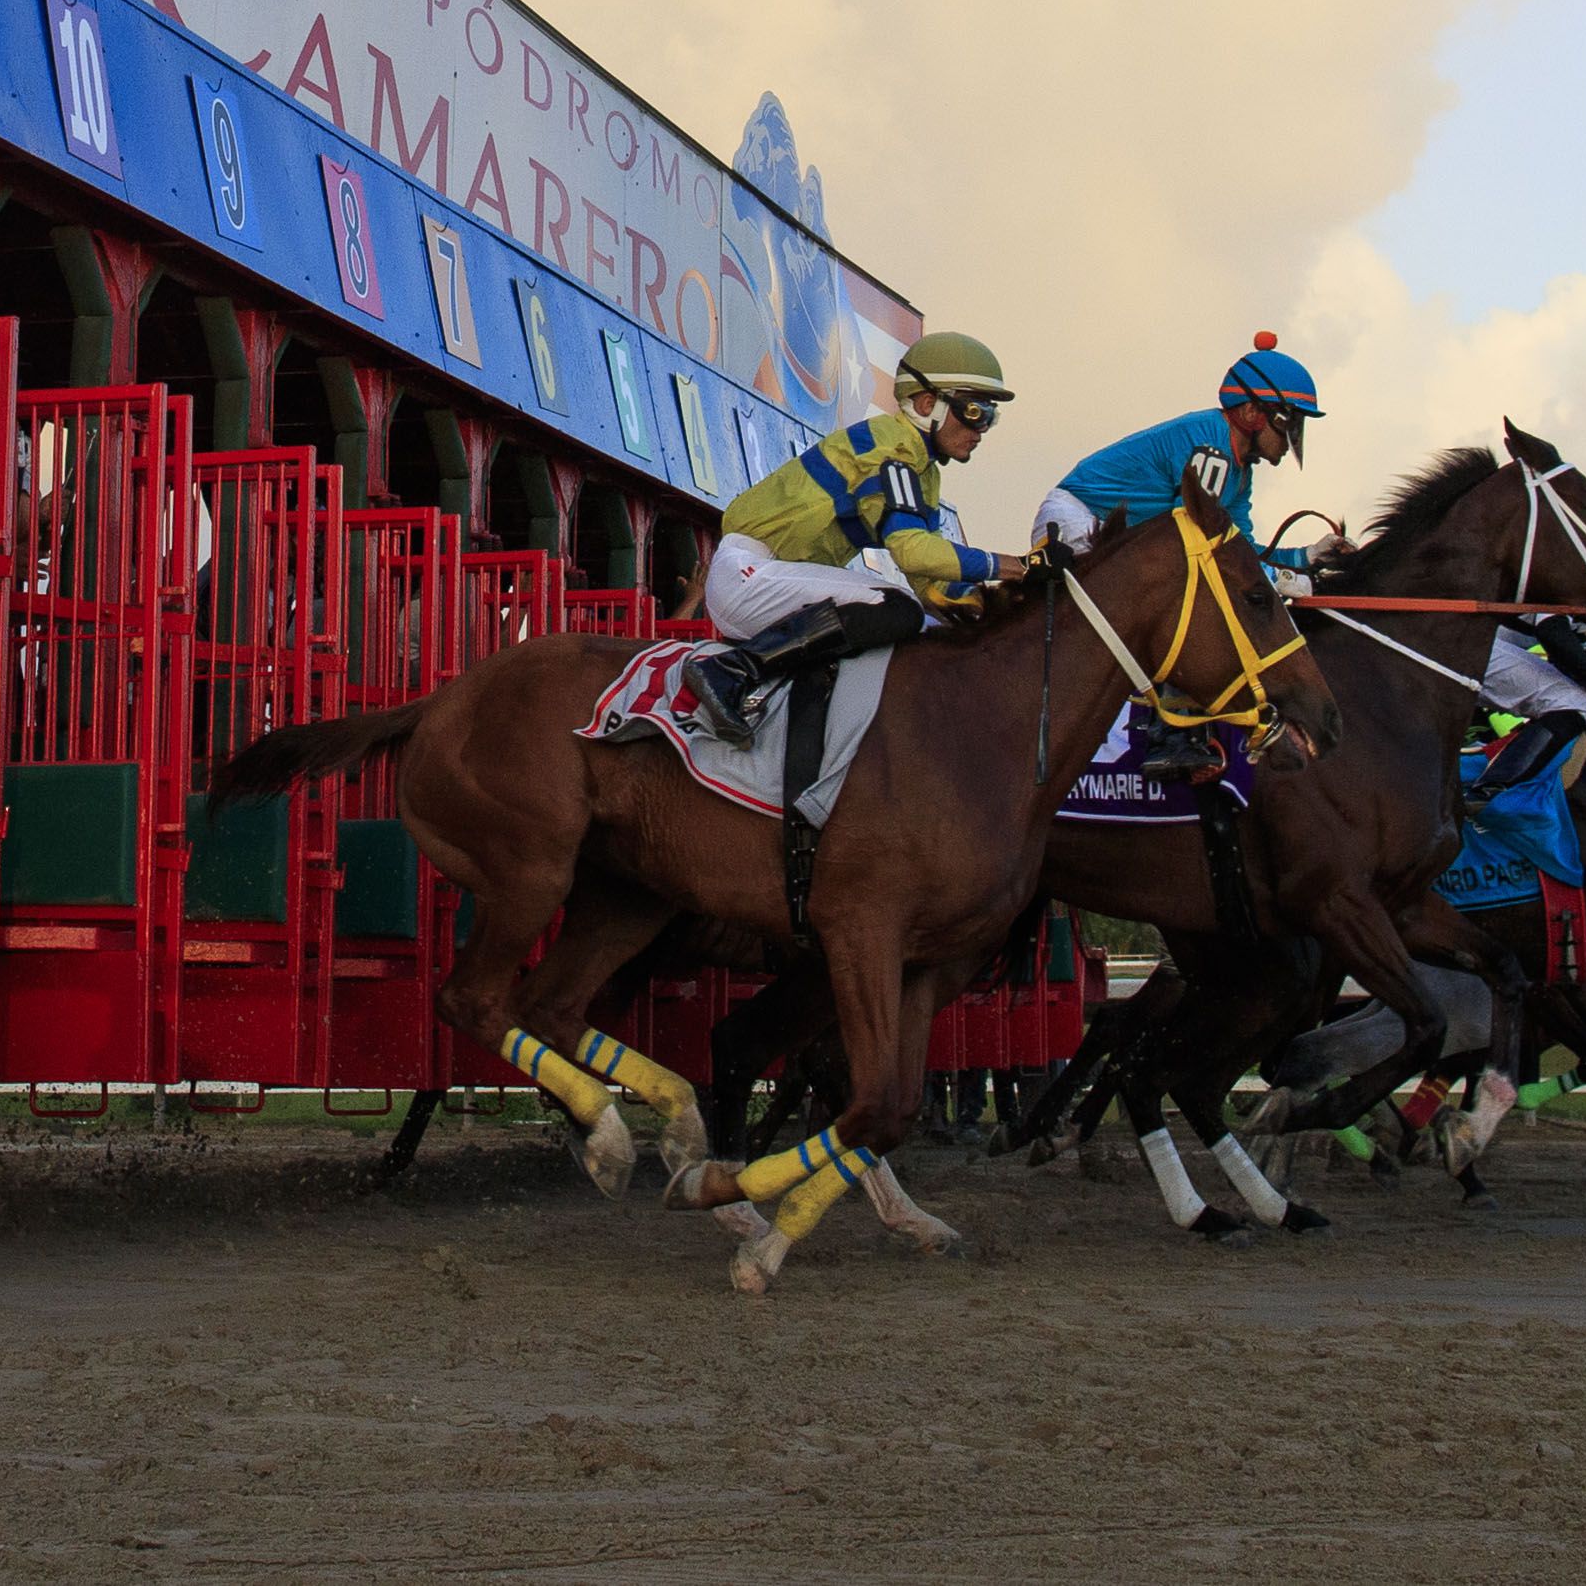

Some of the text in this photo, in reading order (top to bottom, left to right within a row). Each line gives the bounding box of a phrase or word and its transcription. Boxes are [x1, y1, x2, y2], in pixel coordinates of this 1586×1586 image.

[59, 9, 107, 154] 10
[211, 98, 245, 229] 9
[340, 178, 370, 298] 8
[437, 235, 463, 346] 7
[530, 295, 556, 400] 6
[614, 346, 640, 445] 5
[689, 391, 710, 481] 4
[887, 464, 918, 510] 11
[1191, 452, 1229, 497] 10
